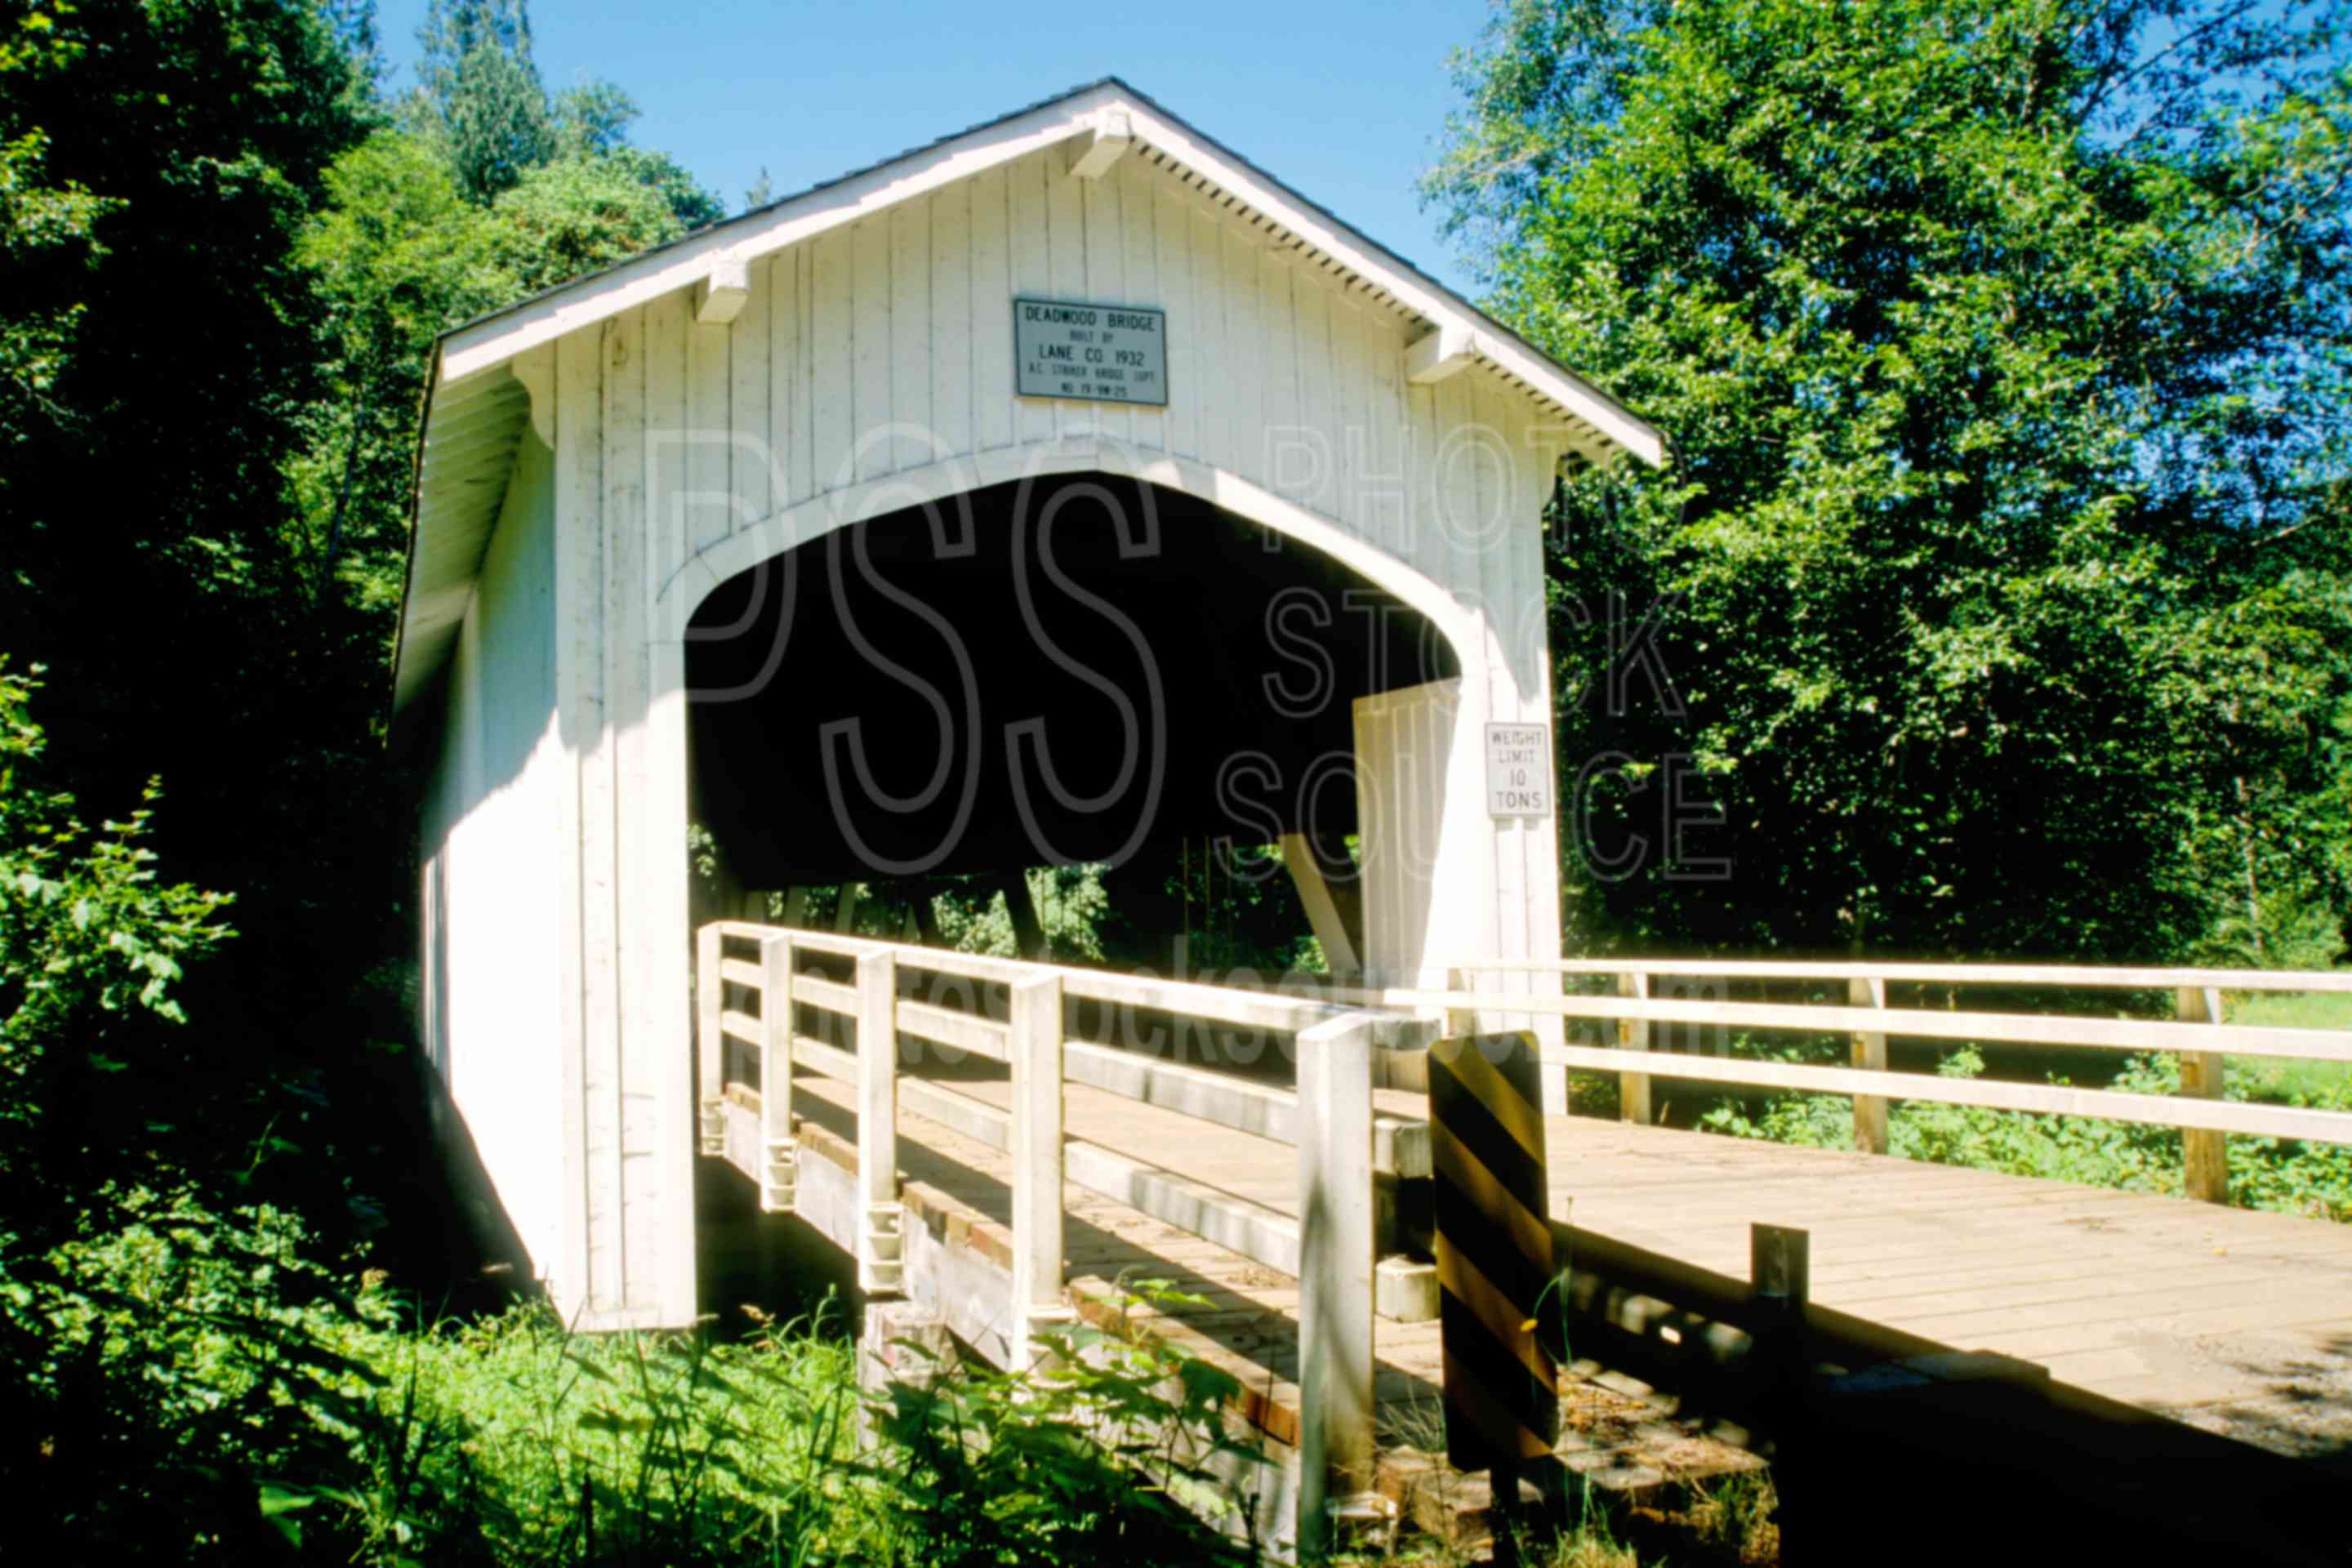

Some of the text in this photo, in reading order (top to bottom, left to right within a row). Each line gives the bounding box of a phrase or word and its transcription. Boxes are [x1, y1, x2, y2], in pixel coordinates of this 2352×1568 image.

[1026, 306, 1155, 331] DEADWOOD BRIDGE
[1102, 332, 1114, 343] BY
[1039, 345, 1074, 361] LANE
[1116, 350, 1145, 366] 1932
[1492, 731, 1542, 745] WEIGHT
[1498, 749, 1535, 763] LIMIT
[1510, 769, 1526, 786] 10
[1496, 791, 1542, 808] TONS
